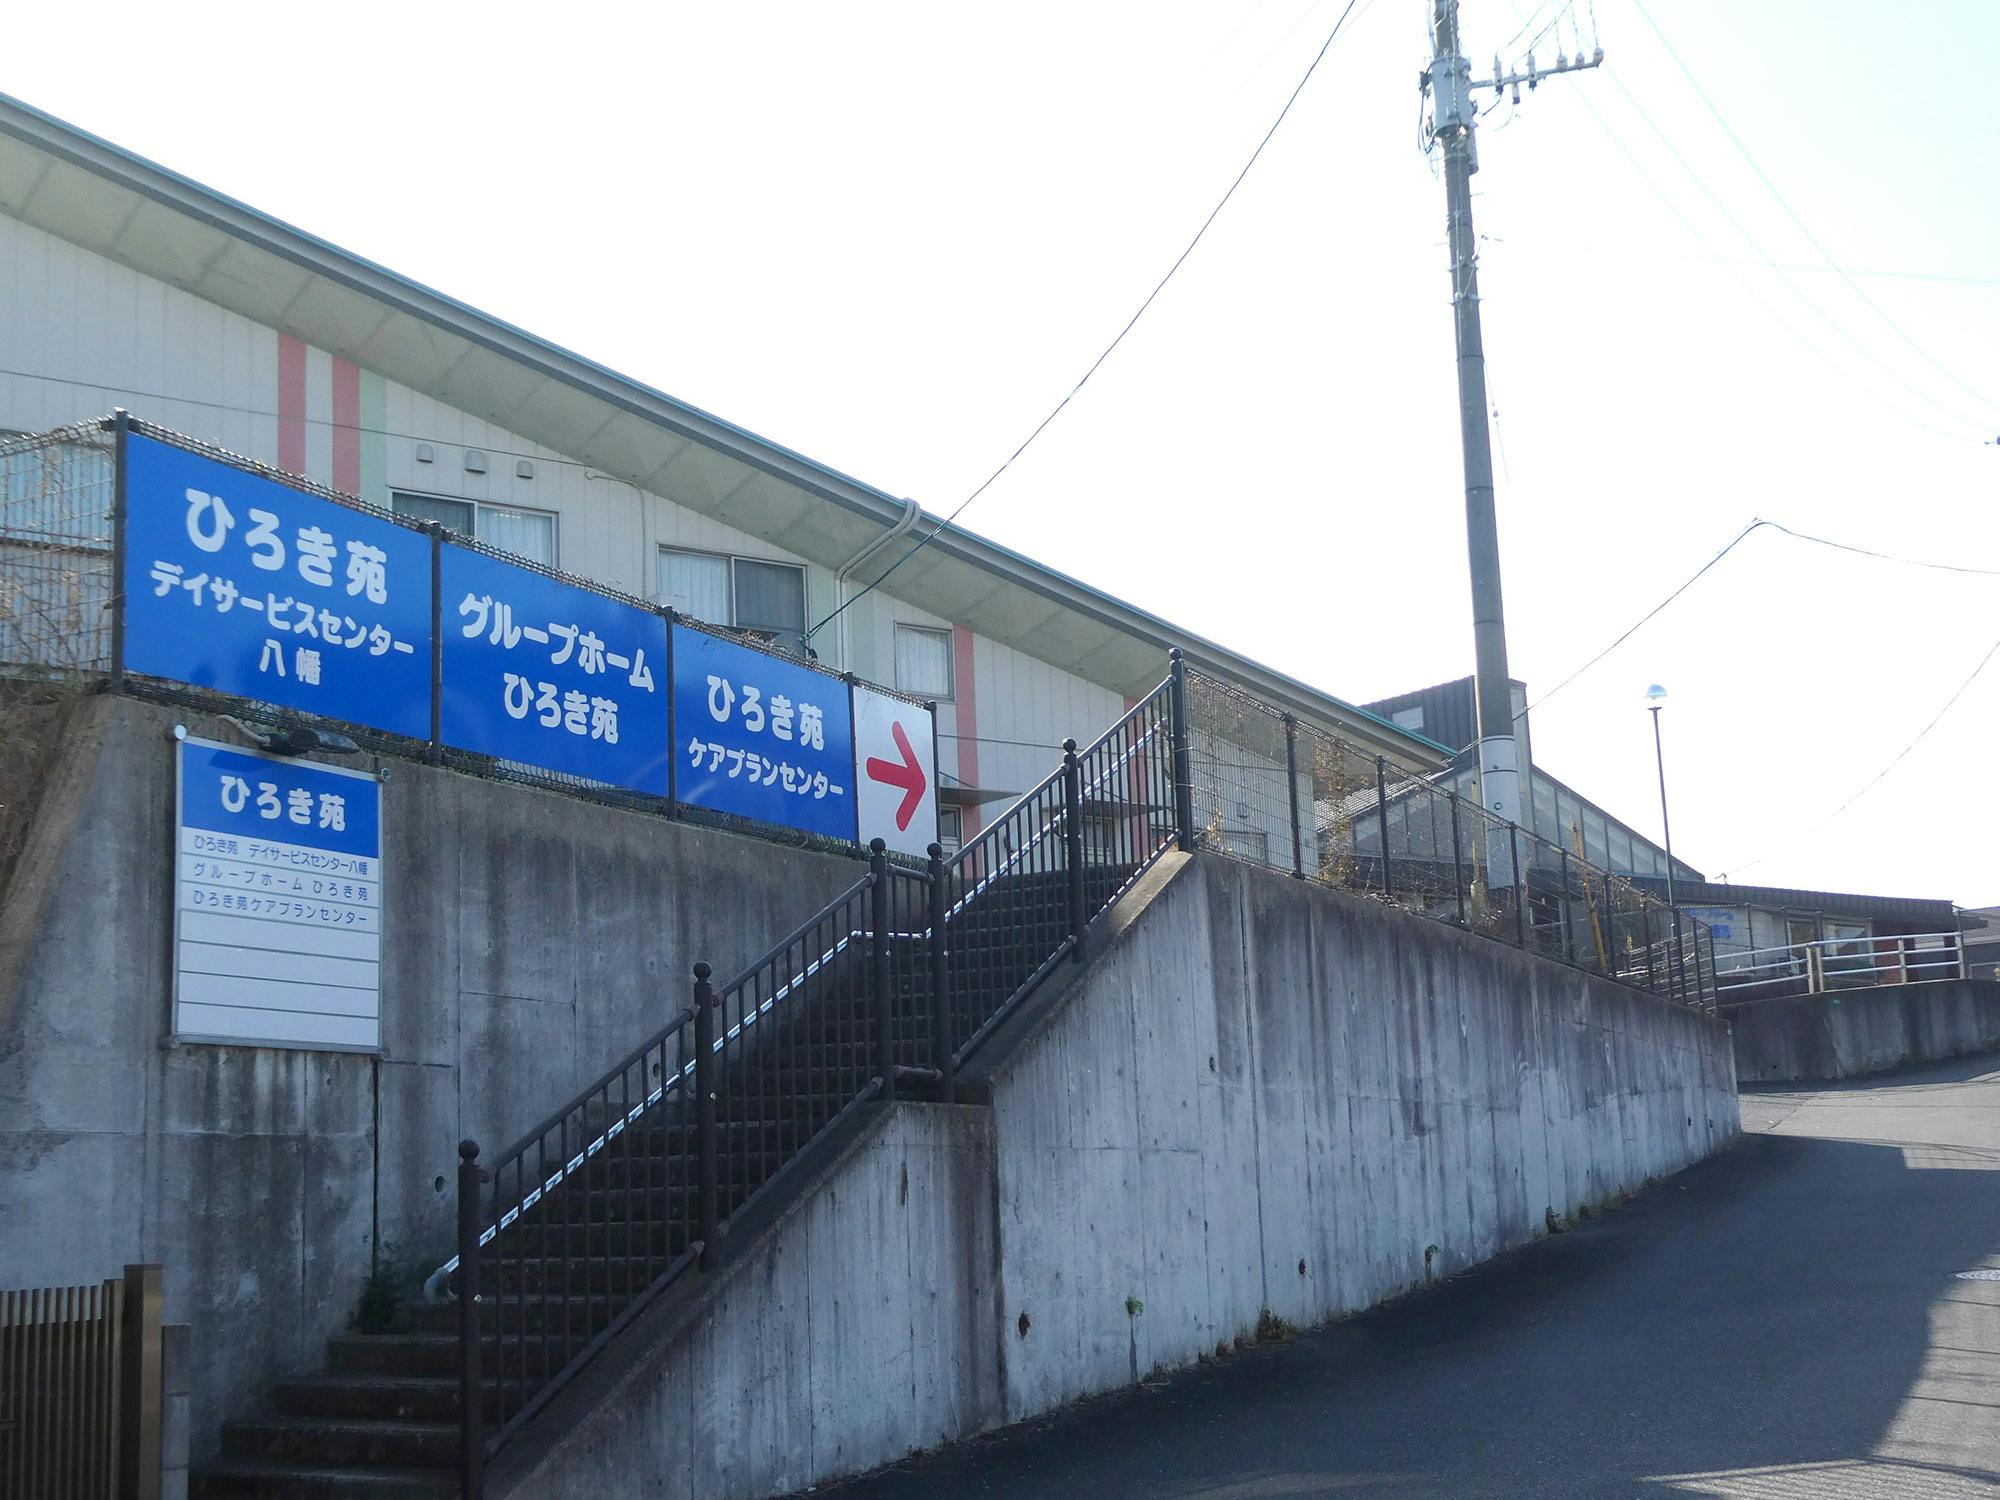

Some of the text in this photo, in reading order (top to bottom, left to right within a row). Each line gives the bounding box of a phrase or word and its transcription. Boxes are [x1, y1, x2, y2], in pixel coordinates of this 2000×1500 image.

[185, 487, 388, 605] ひろき苑
[150, 560, 414, 656] デイサービスセンター
[458, 592, 655, 693] グループホーム
[259, 638, 321, 686] 八幡
[503, 672, 619, 745] ひろき苑
[706, 674, 825, 751] ひろき苑
[688, 736, 844, 801] ケアプランセンター
[220, 775, 346, 832] ひろき苑
[194, 834, 238, 855] ひろき苑
[193, 861, 368, 901] グループホーム ひろき苑
